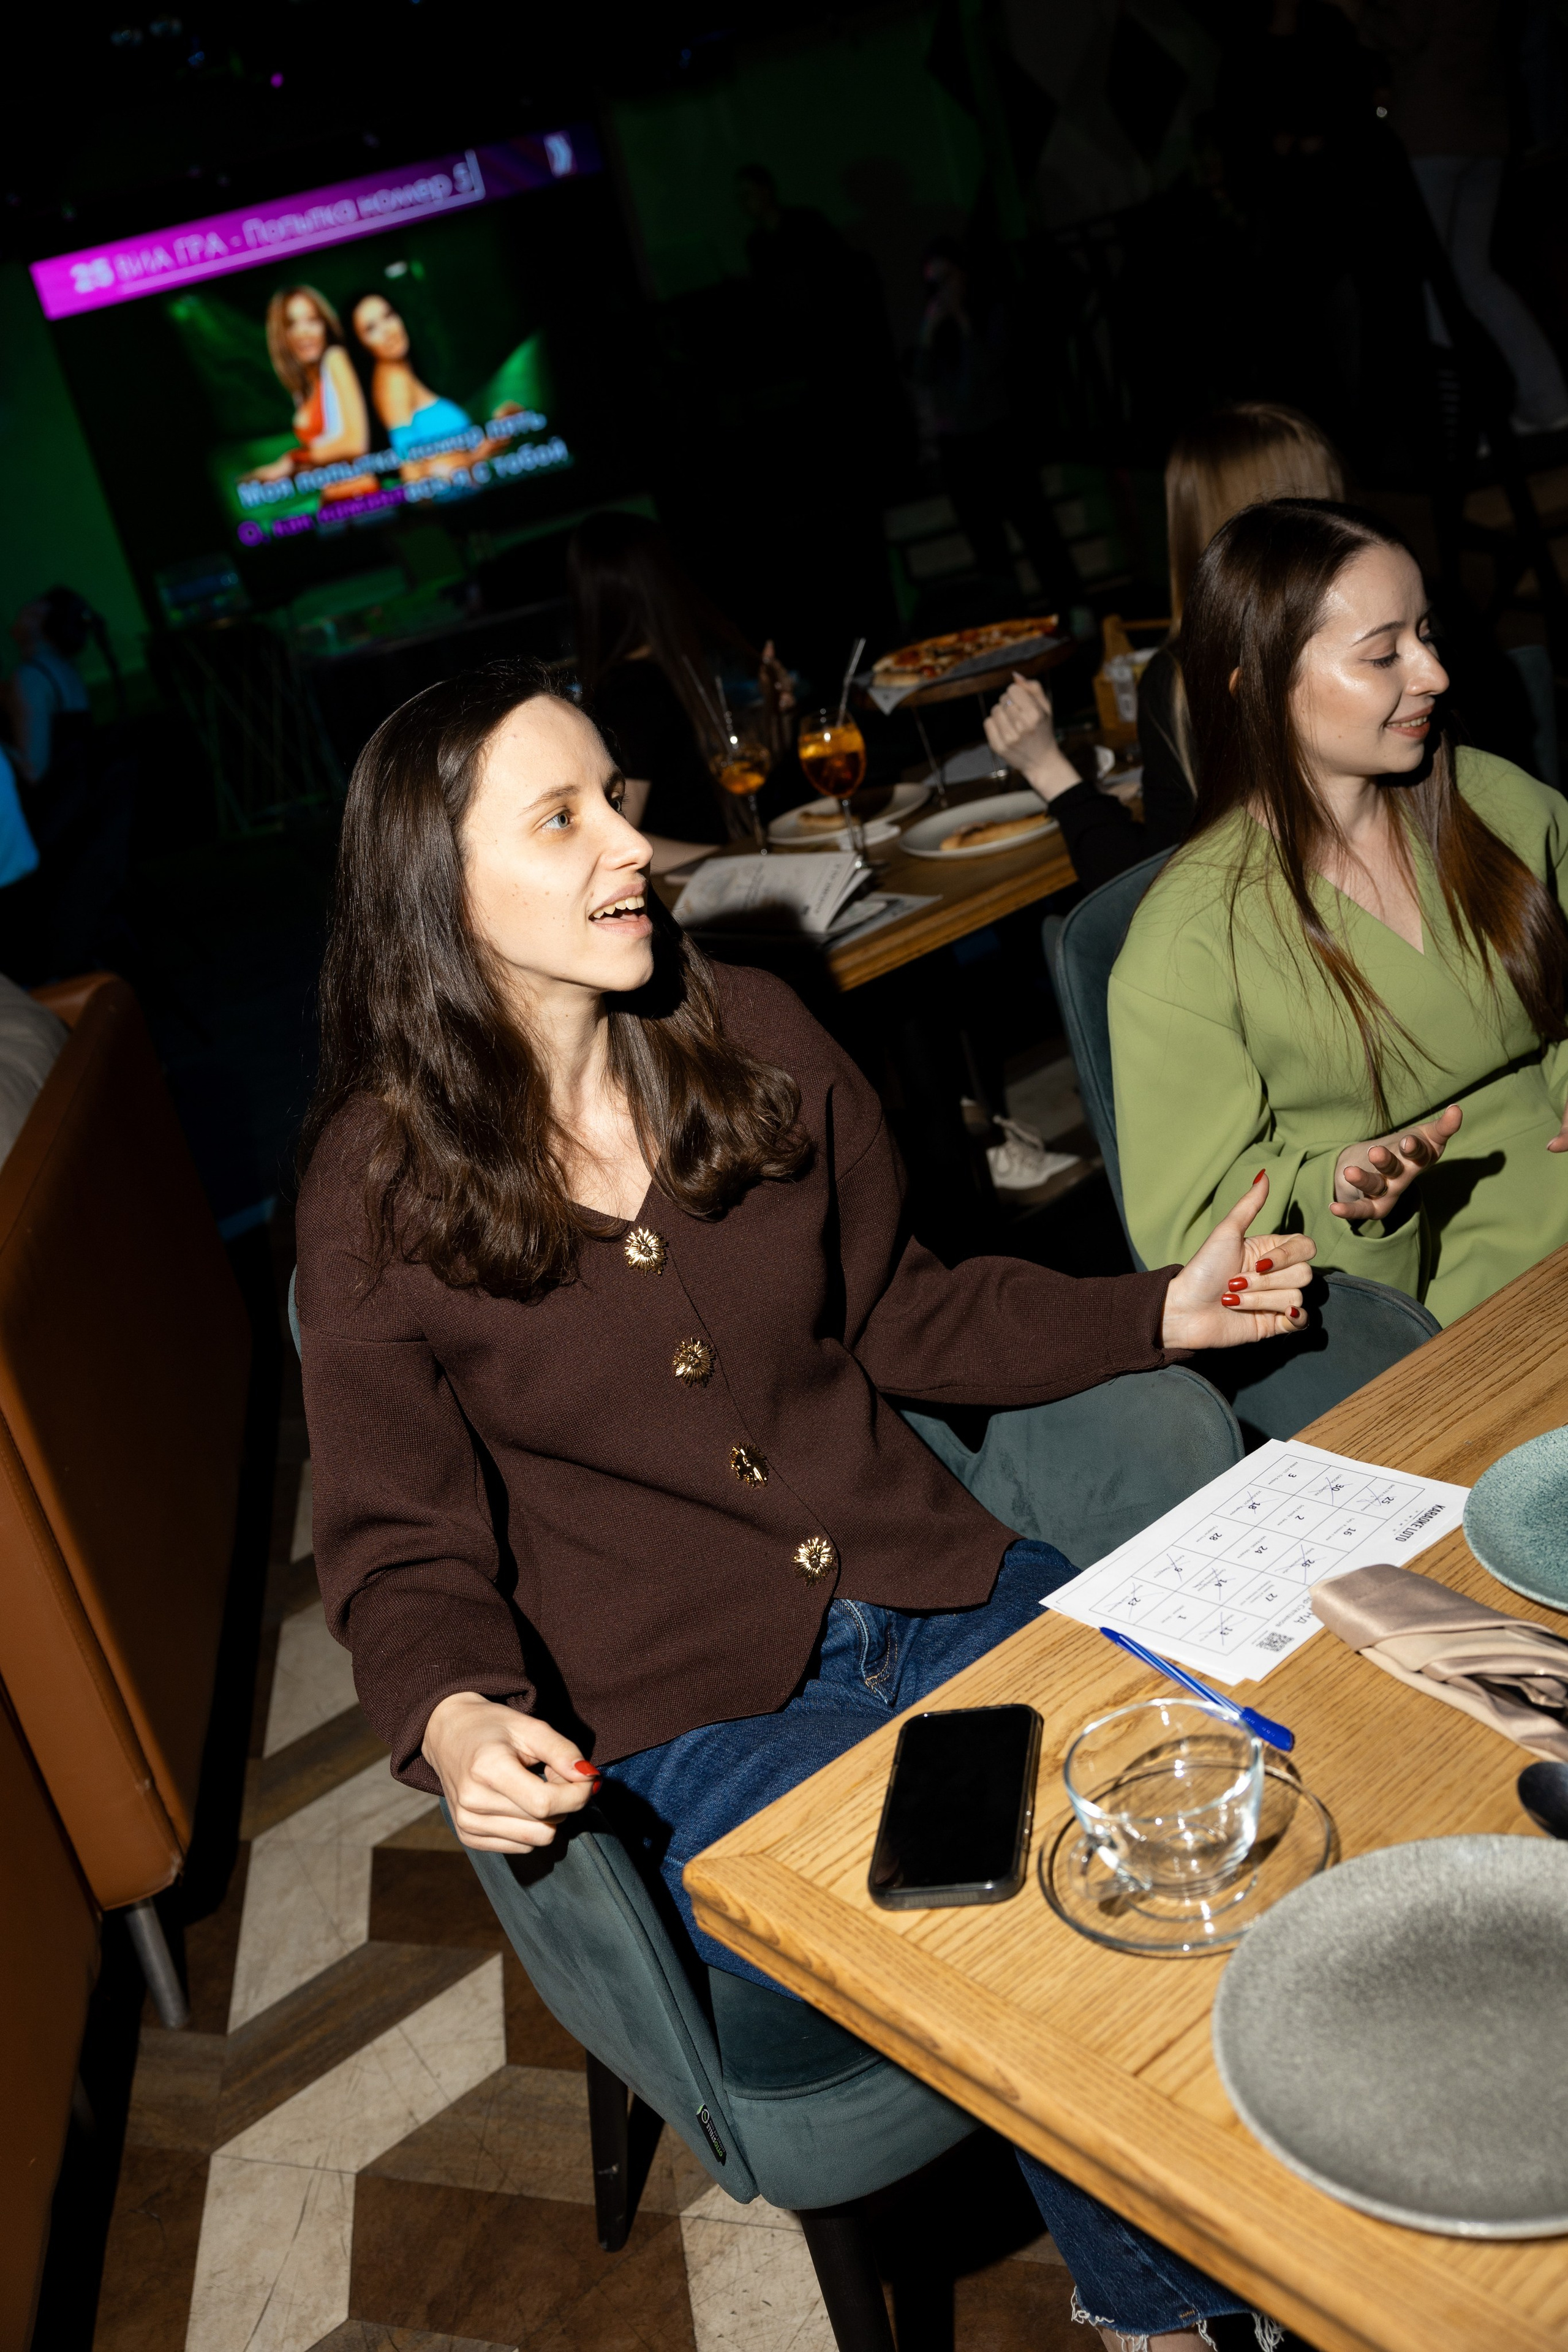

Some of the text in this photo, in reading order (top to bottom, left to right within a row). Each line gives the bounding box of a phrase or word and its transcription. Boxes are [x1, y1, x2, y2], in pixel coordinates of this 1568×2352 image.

[69, 257, 115, 294] 25
[492, 435, 569, 478] тобой
[238, 478, 295, 508] Моя
[1248, 1502, 1261, 1510] 18
[1395, 1504, 1446, 1542] KARAOKE LOTO
[1128, 1597, 1140, 1606] 23
[706, 2123, 723, 2157] OTTOSTELLE
